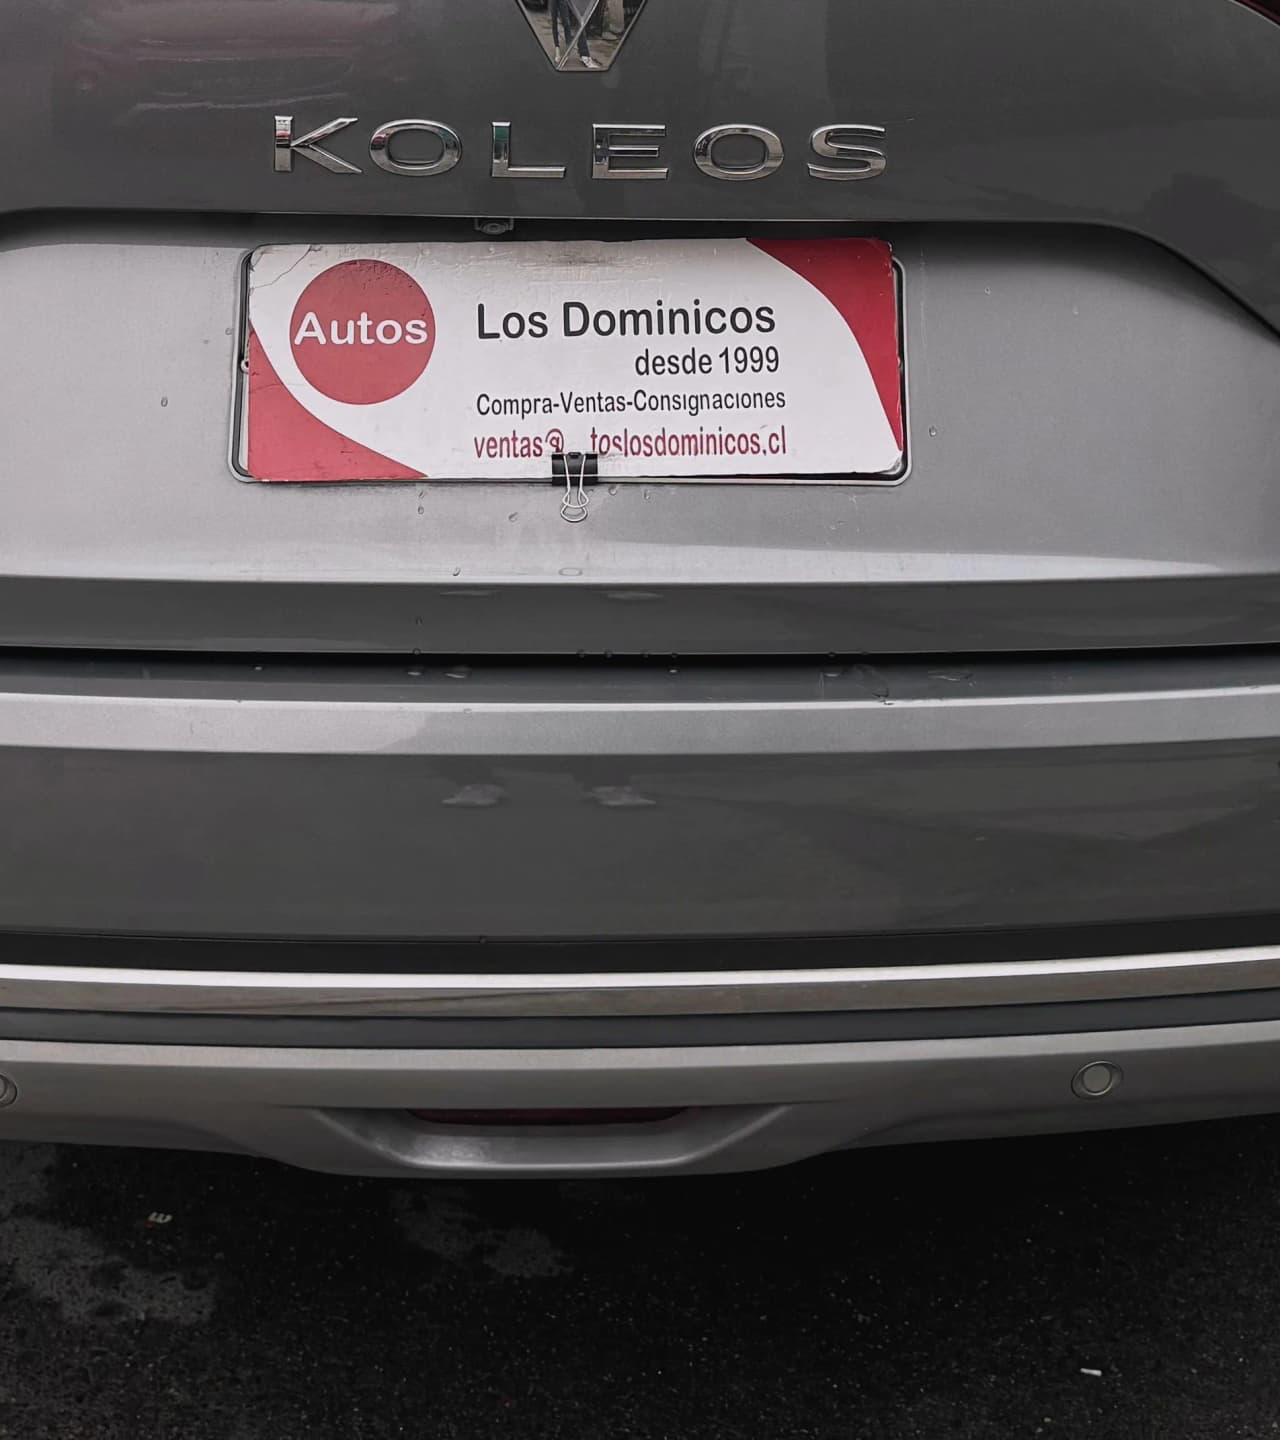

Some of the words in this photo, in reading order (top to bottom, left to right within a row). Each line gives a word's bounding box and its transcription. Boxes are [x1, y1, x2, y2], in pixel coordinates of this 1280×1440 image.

[273, 115, 888, 181] KOLEOS
[293, 310, 429, 346] Autos
[477, 302, 549, 340] Los
[562, 298, 776, 337] Dominicos
[634, 347, 713, 376] desde
[718, 345, 780, 375] 1999
